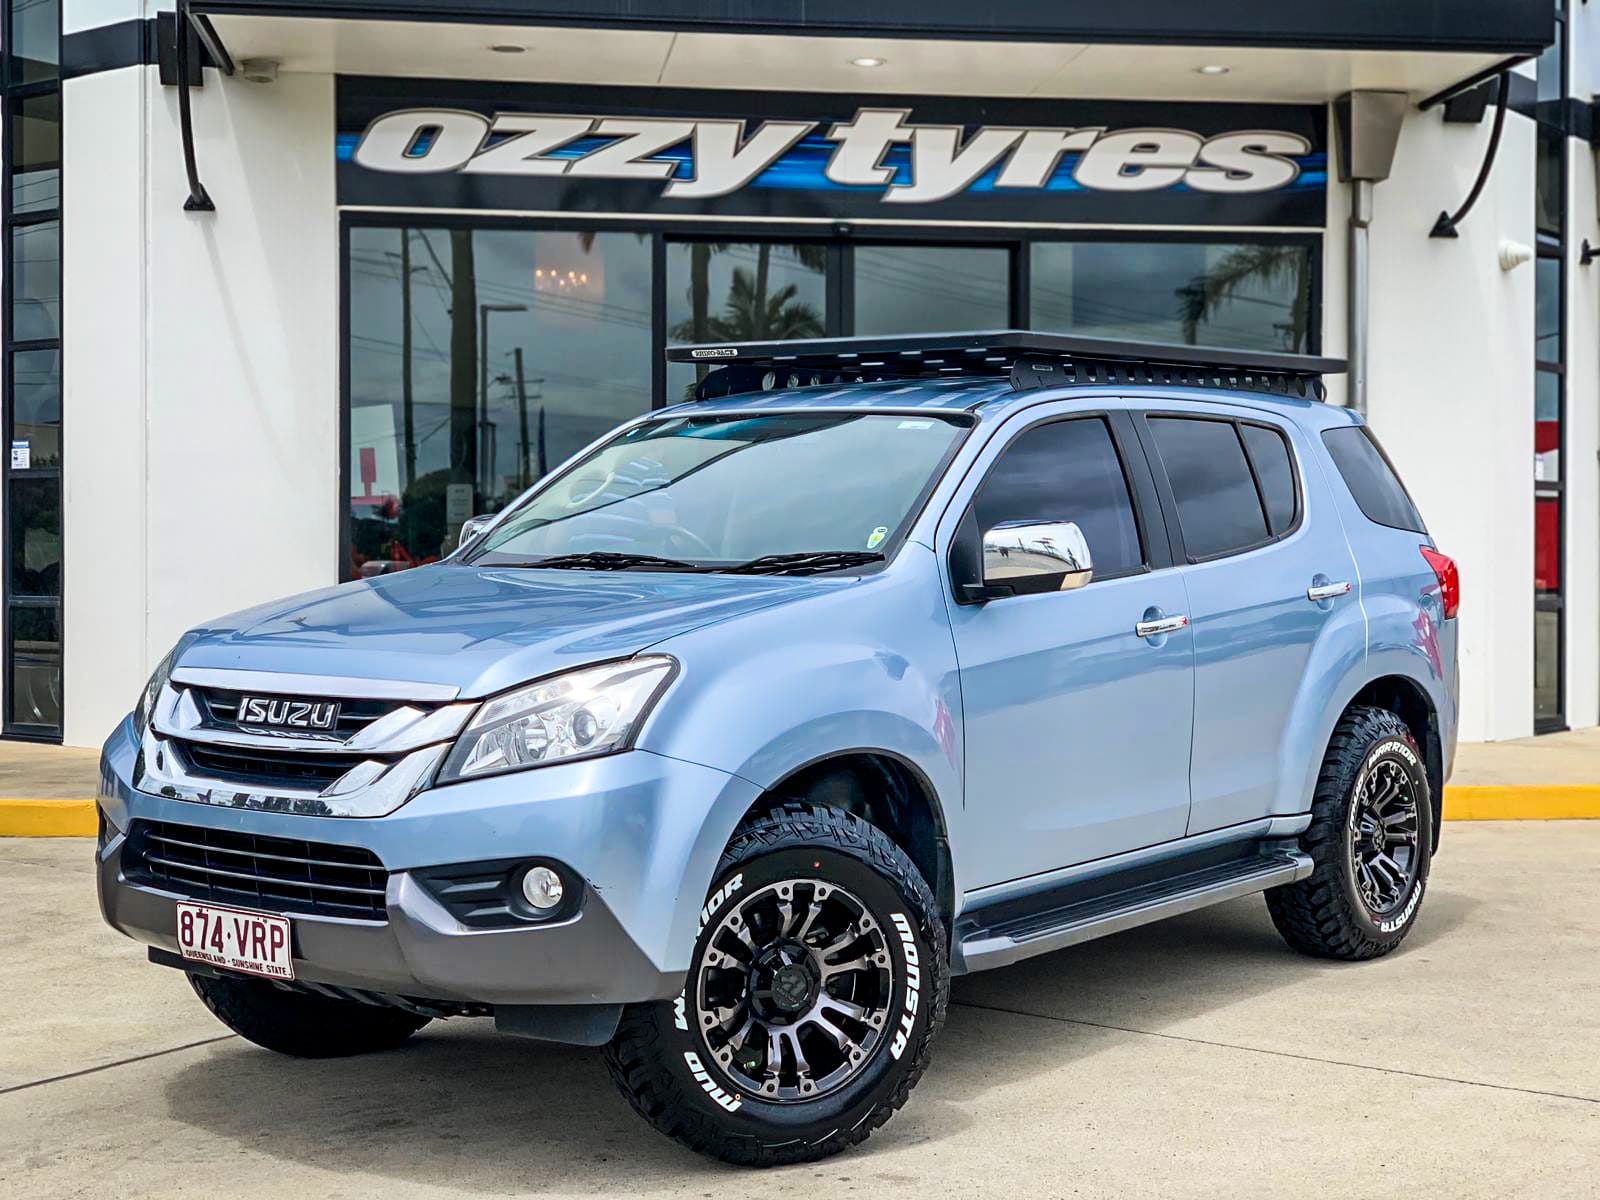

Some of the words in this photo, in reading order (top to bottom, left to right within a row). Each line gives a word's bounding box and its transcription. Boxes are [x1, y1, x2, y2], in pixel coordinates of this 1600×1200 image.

[353, 107, 820, 198] ozzy
[825, 107, 1312, 203] tyres
[238, 697, 336, 728] ISUZU
[1368, 741, 1417, 768] WARRIOR
[1380, 880, 1421, 933] MONSTA
[185, 949, 226, 964] QUEENSLAND
[231, 958, 263, 972] SUNSHINE
[266, 965, 287, 976] STATE
[890, 913, 920, 1060] MONSTA
[684, 1052, 742, 1112] MUD
